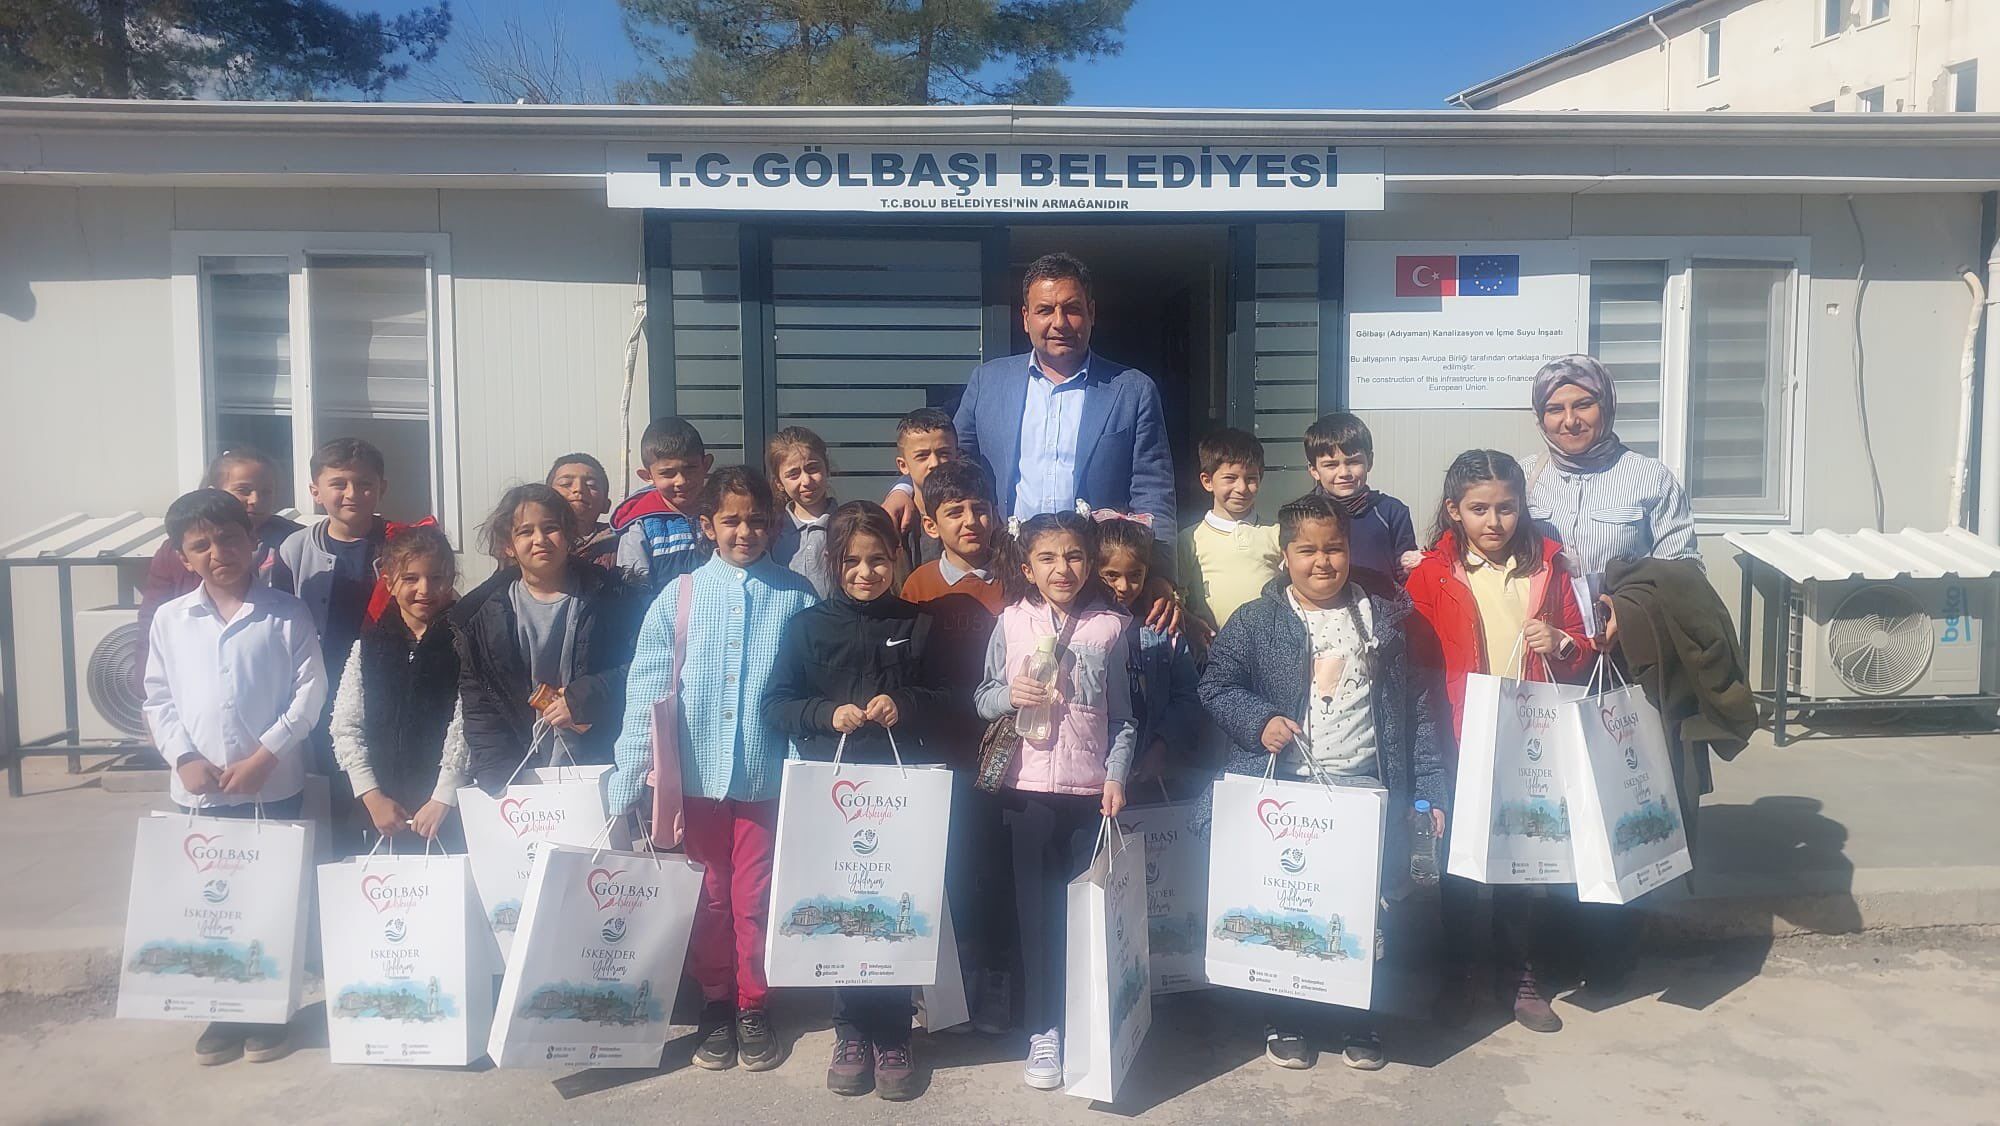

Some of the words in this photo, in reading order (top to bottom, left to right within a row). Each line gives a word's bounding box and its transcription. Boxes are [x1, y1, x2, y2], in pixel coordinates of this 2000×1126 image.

[648, 145, 997, 196] T.C.GÖLBAŞI
[1020, 145, 1338, 188] BELEDİYESİ
[881, 198, 937, 209] T.C.BOLU
[940, 197, 1038, 209] BELEDİYESİ'NİN
[1042, 197, 1129, 209] ARMAĞANIDIR
[1356, 330, 1386, 339] Gölbaşı
[1387, 329, 1431, 339] (Adıyaman)
[1432, 329, 1484, 338] Kanalizasyon
[1496, 328, 1514, 338] İçme
[1516, 329, 1536, 338] Suyu
[1538, 328, 1564, 338] İnşaatı
[1350, 355, 1360, 363] Bu
[1362, 354, 1397, 364] altyapının
[1421, 354, 1446, 363] Avrupa
[1470, 353, 1505, 361] tarafından
[1356, 376, 1370, 384] The
[1372, 375, 1415, 383] construction
[1416, 375, 1424, 383] of
[1426, 375, 1439, 383] this
[1440, 374, 1487, 383] infrastructure
[1488, 374, 1496, 382] is
[1429, 384, 1462, 392] European
[1940, 586, 1961, 642] beko
[840, 793, 908, 810] GÖLBAŞI
[509, 809, 566, 824] GÖLBAŞI
[1266, 812, 1334, 833] GÖLBAŞI
[192, 845, 260, 863] GÖLBAŞI
[834, 857, 892, 872] İSKENDER
[1263, 874, 1320, 892] İSKENDER
[370, 885, 429, 900] GÖLBAŞI
[594, 881, 660, 901] GÖLBAŞI
[184, 906, 243, 920] İSKENDER
[370, 946, 421, 960] İSKENDER
[581, 945, 636, 960] İSKENDER
